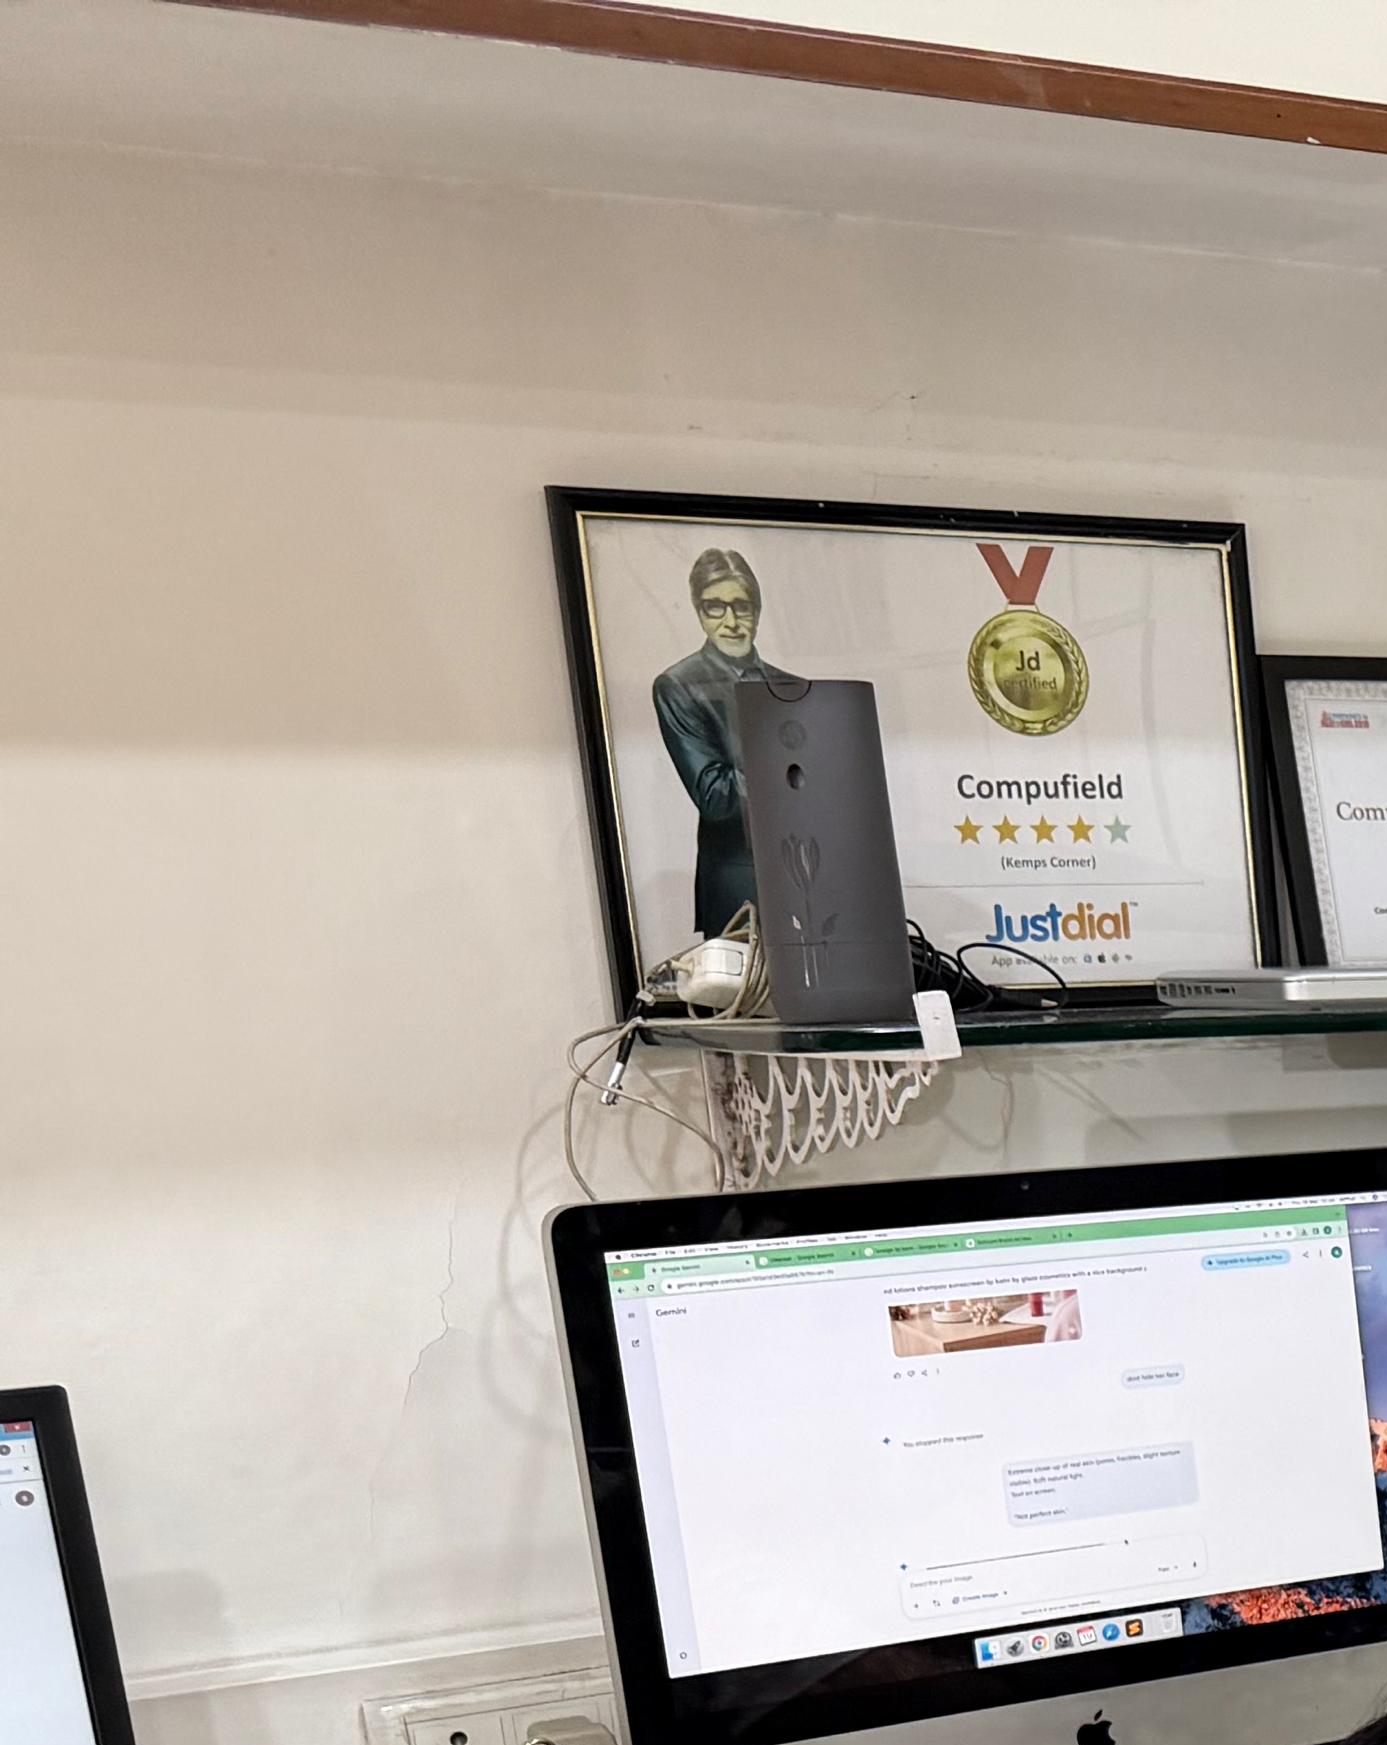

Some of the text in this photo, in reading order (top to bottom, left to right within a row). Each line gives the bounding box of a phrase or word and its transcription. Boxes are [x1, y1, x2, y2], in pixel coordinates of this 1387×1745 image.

[1017, 651, 1040, 671] Jd
[958, 774, 1122, 805] Compufield
[1001, 856, 1096, 870] (Kemps Corner)
[986, 902, 1131, 944] Justdial
[656, 1308, 686, 1316] Gemini
